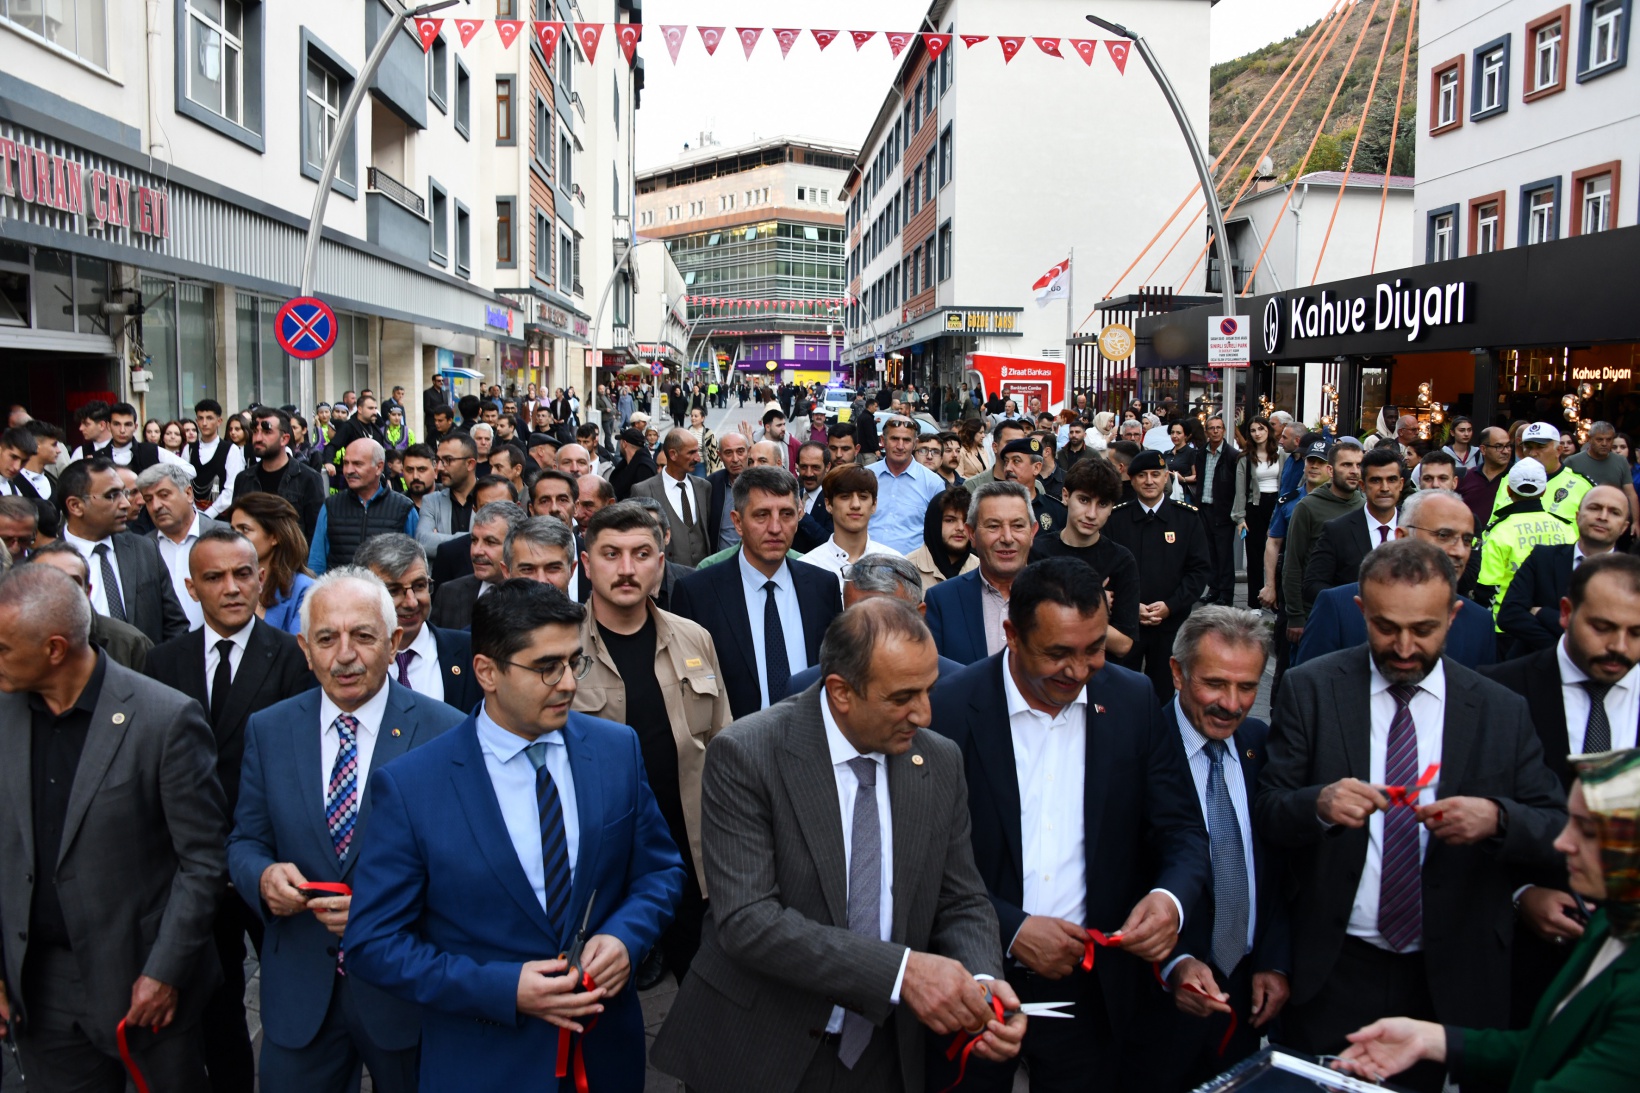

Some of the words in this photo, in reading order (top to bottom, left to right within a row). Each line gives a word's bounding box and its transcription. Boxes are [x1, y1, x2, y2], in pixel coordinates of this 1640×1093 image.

[0, 136, 84, 215] TURAN
[92, 168, 131, 230] ÇAY
[138, 186, 170, 239] EVİ
[1374, 279, 1465, 342] Diyarı
[1008, 367, 1027, 376] Ziraat
[1027, 368, 1052, 376] Bankası
